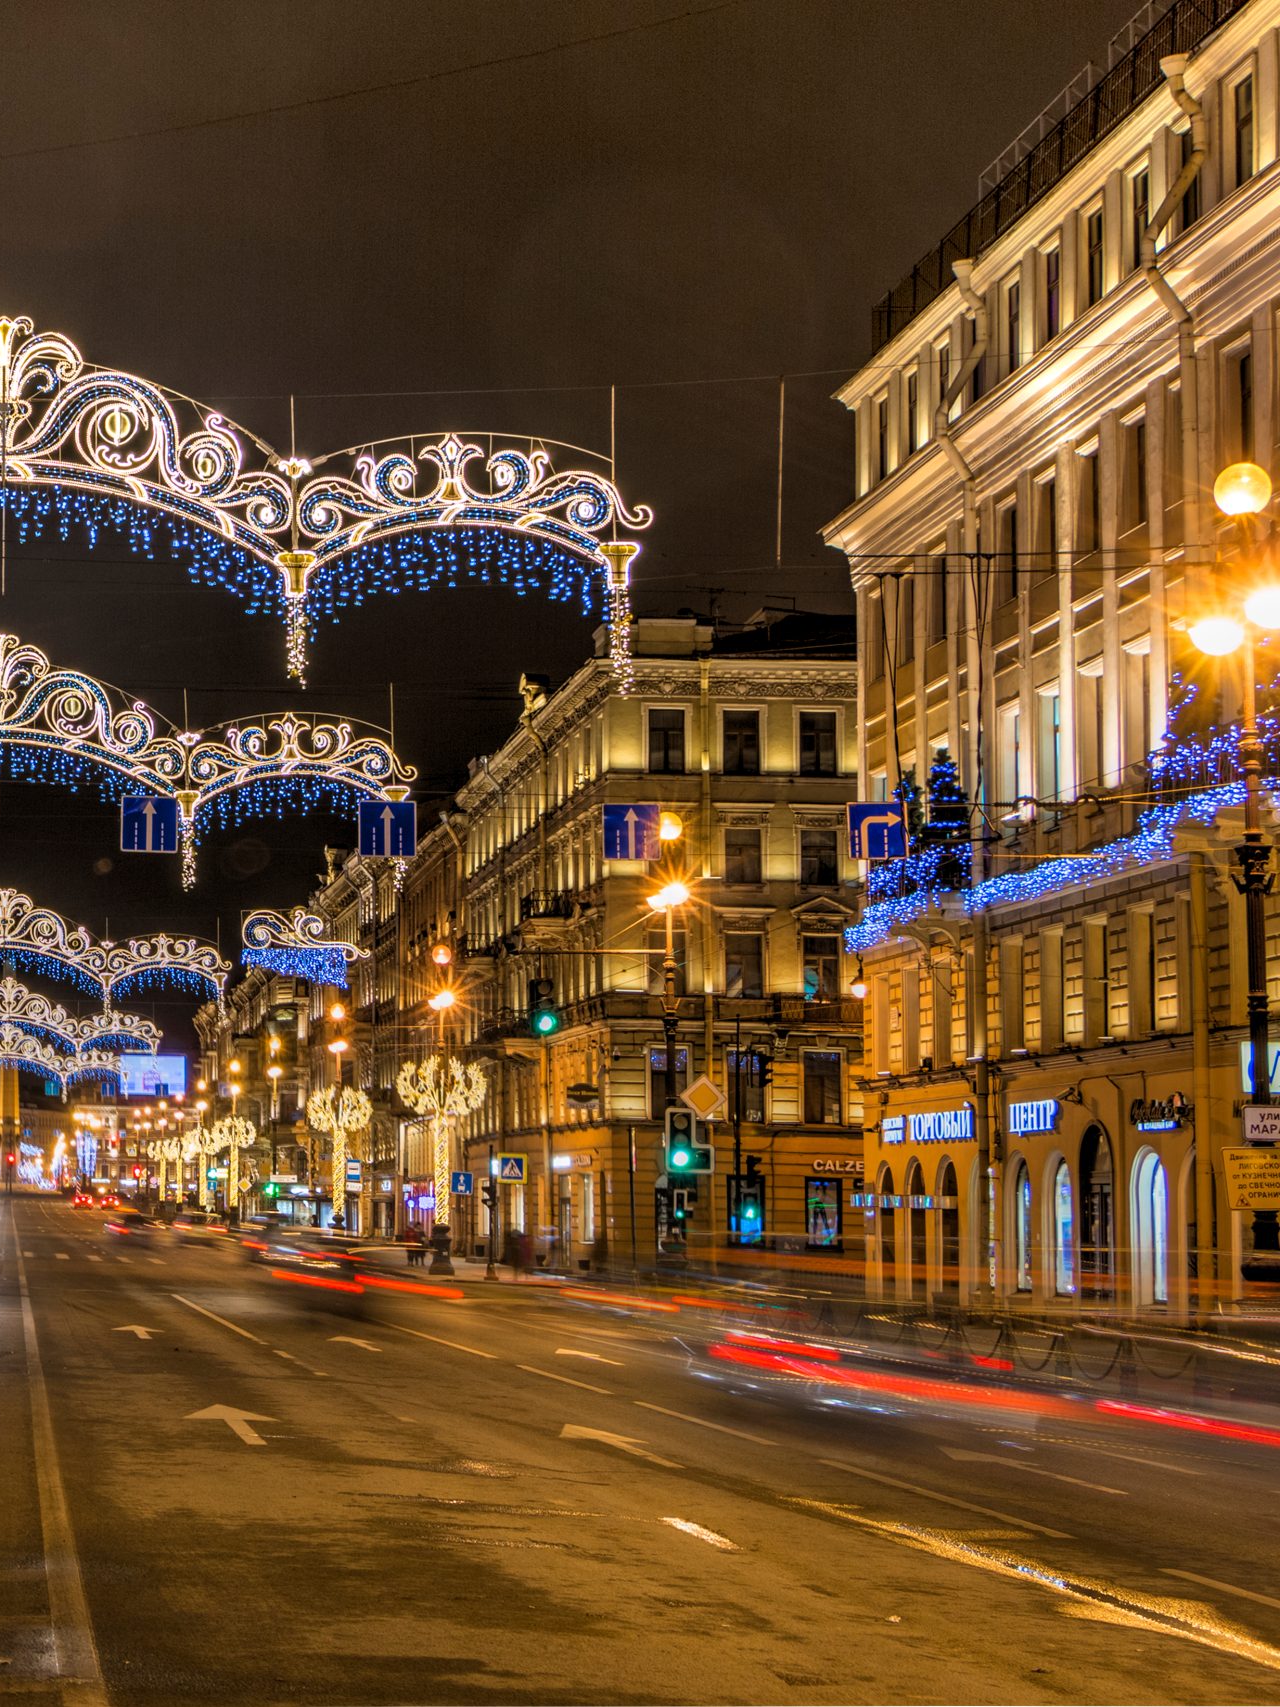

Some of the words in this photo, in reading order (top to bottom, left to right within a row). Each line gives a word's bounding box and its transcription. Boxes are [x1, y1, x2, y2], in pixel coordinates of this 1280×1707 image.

[908, 1101, 973, 1141] ТОРГОВЫЙ
[1009, 1099, 1057, 1137] ЦЕНТР
[1250, 1123, 1280, 1135] МАР
